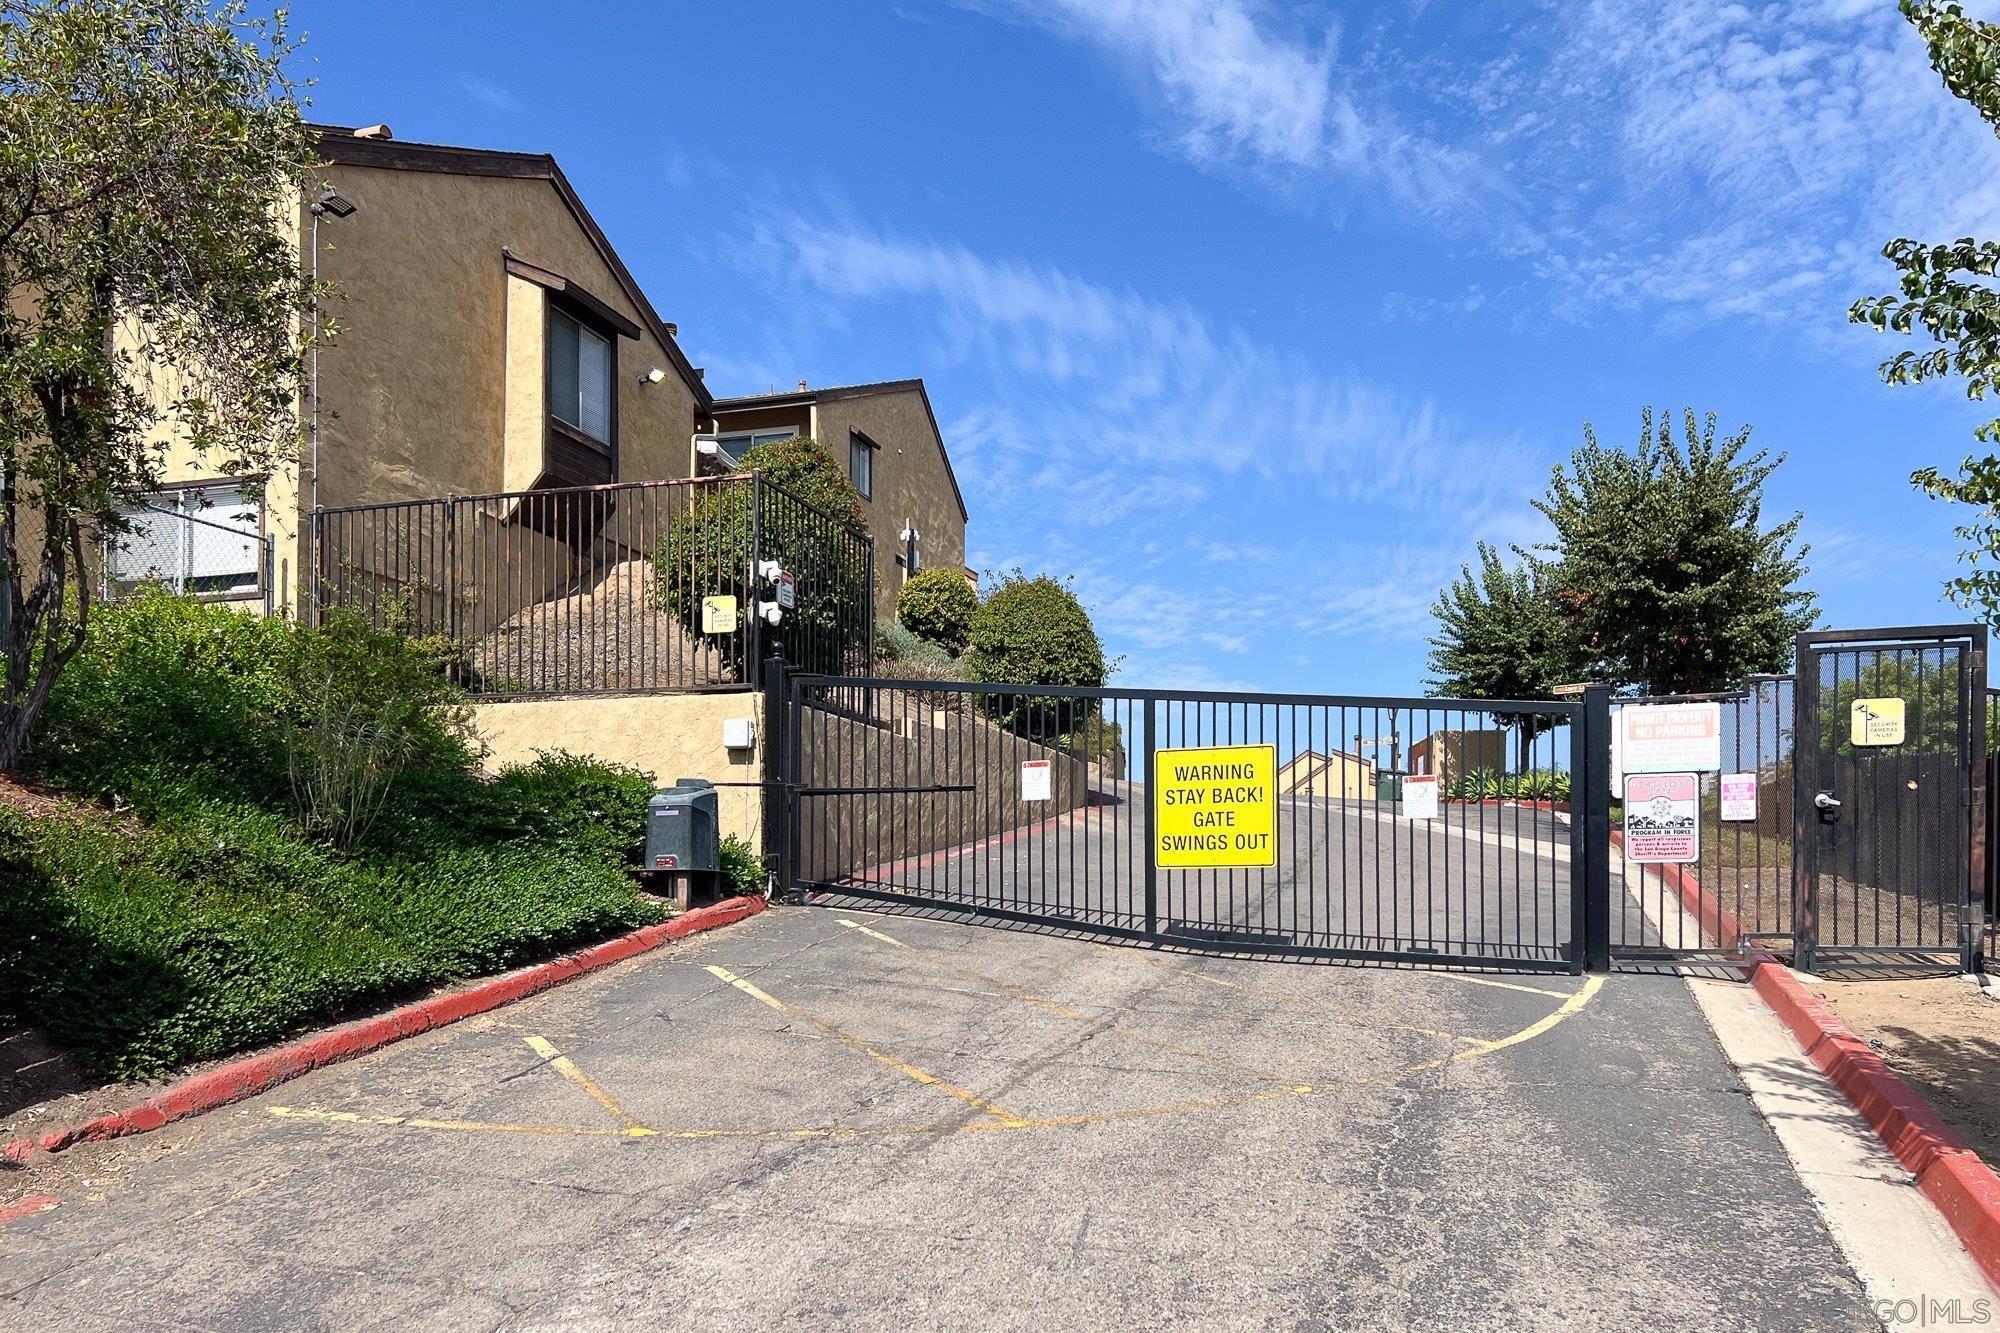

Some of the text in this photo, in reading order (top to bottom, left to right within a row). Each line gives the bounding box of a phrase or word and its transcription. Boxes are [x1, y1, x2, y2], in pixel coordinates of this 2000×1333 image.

[1636, 724, 1707, 738] NO PARKING
[1174, 763, 1254, 782] WARNING
[1166, 786, 1263, 805] STAY BACK!
[1194, 811, 1235, 827] GATE
[1162, 834, 1269, 851] SWINGS OUT
